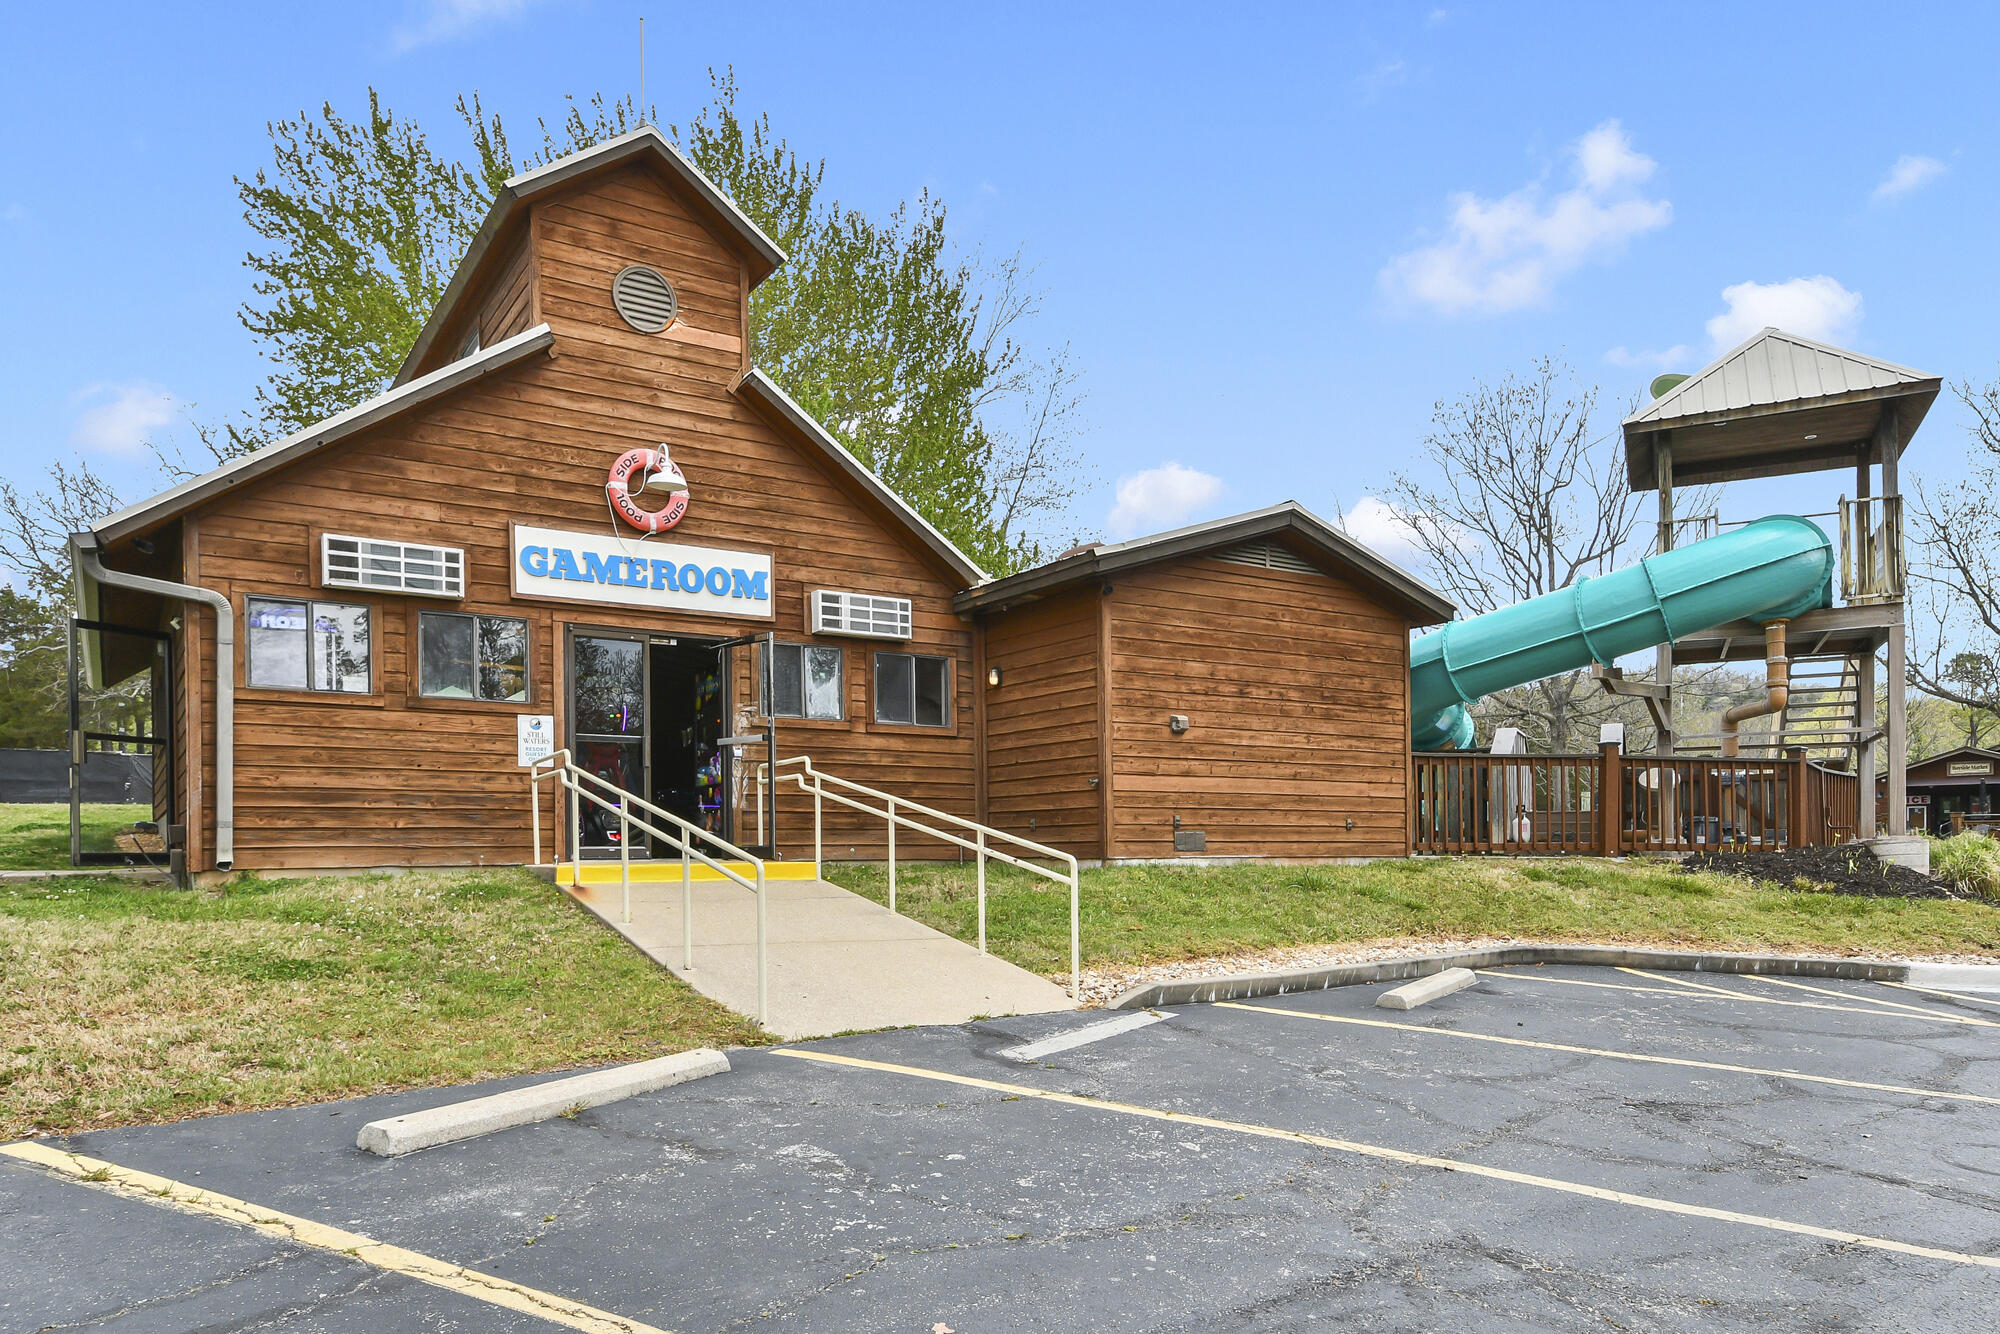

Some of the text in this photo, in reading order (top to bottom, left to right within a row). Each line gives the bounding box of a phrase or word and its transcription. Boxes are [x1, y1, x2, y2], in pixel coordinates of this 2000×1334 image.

[616, 453, 640, 477] SIDE
[616, 493, 643, 523] POOL
[662, 501, 685, 525] SIDE
[520, 545, 768, 600] GAMEROOM
